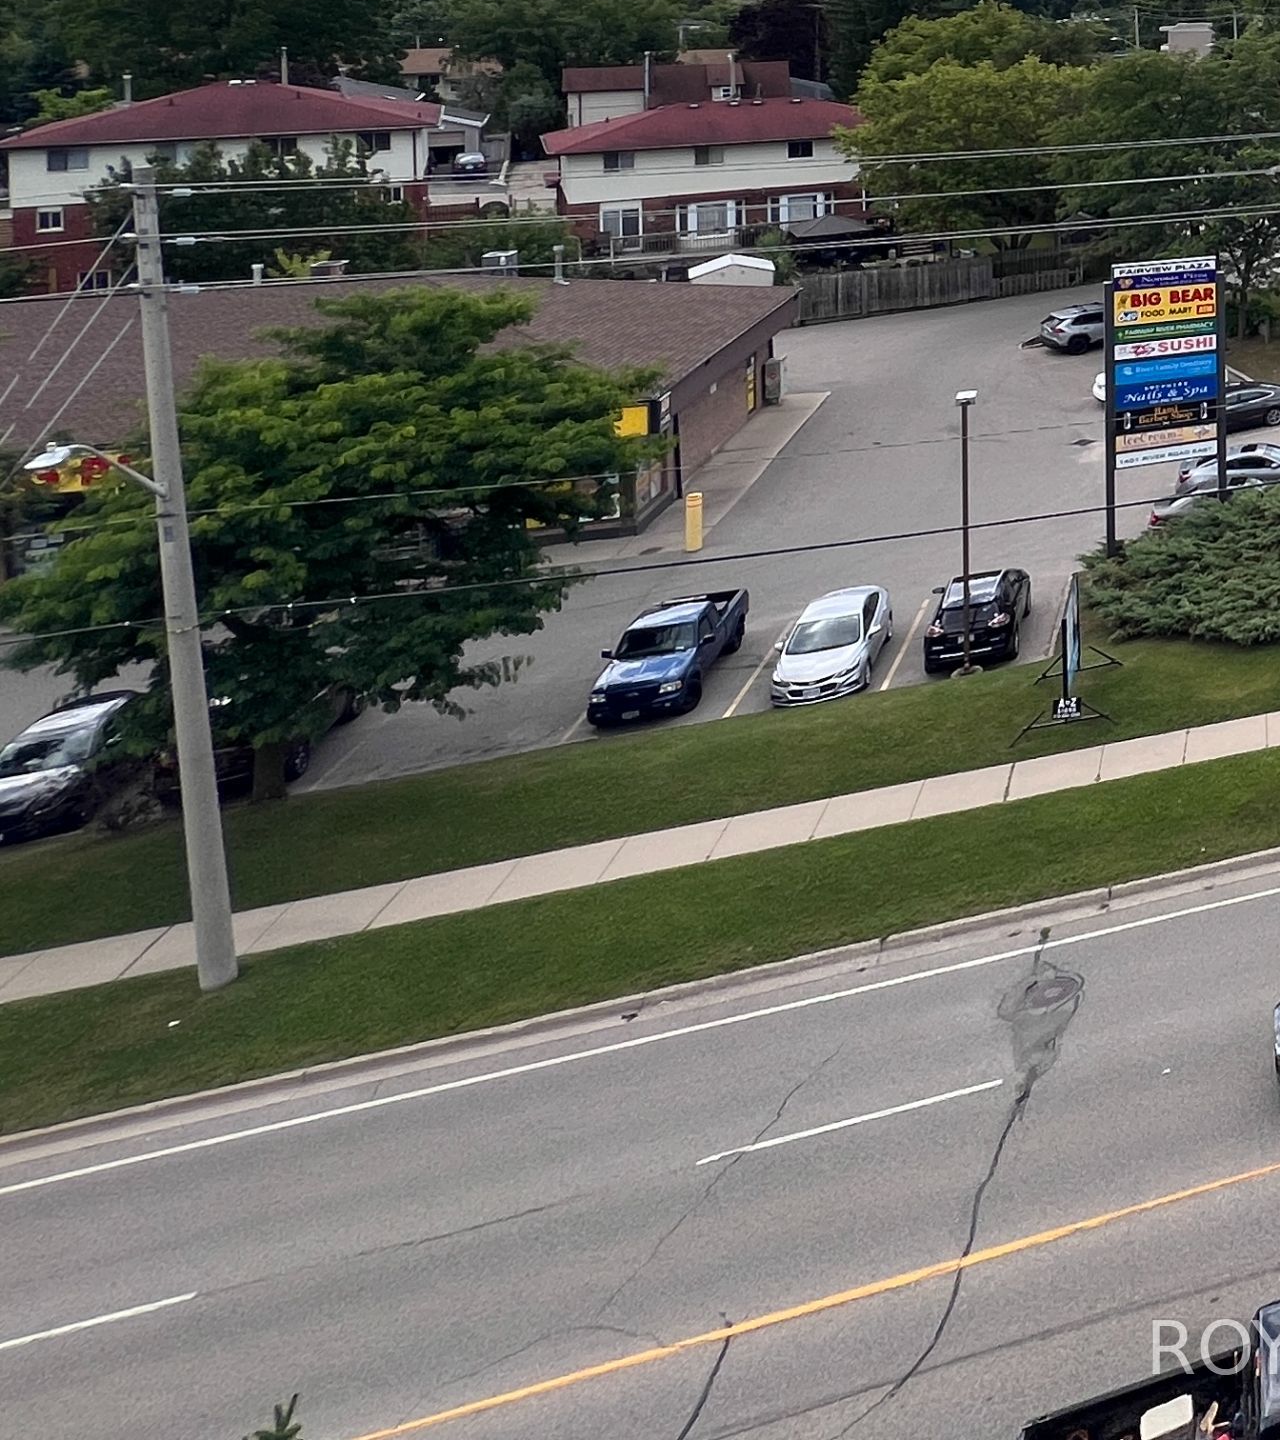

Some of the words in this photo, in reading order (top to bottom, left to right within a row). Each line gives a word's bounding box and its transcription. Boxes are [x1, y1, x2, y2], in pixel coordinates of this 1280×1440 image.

[1119, 265, 1172, 275] FAIRVIEW
[1130, 292, 1161, 307] BIG
[1169, 287, 1214, 304] BEAR
[1140, 309, 1165, 318] FOOD
[1168, 307, 1192, 315] MART
[1175, 321, 1214, 331] PHARMACY
[1158, 336, 1214, 353] SUSHI
[1123, 390, 1163, 403] Nails
[1167, 388, 1178, 397] &
[1183, 385, 1208, 398] Spa
[1167, 449, 1190, 457] ROAD
